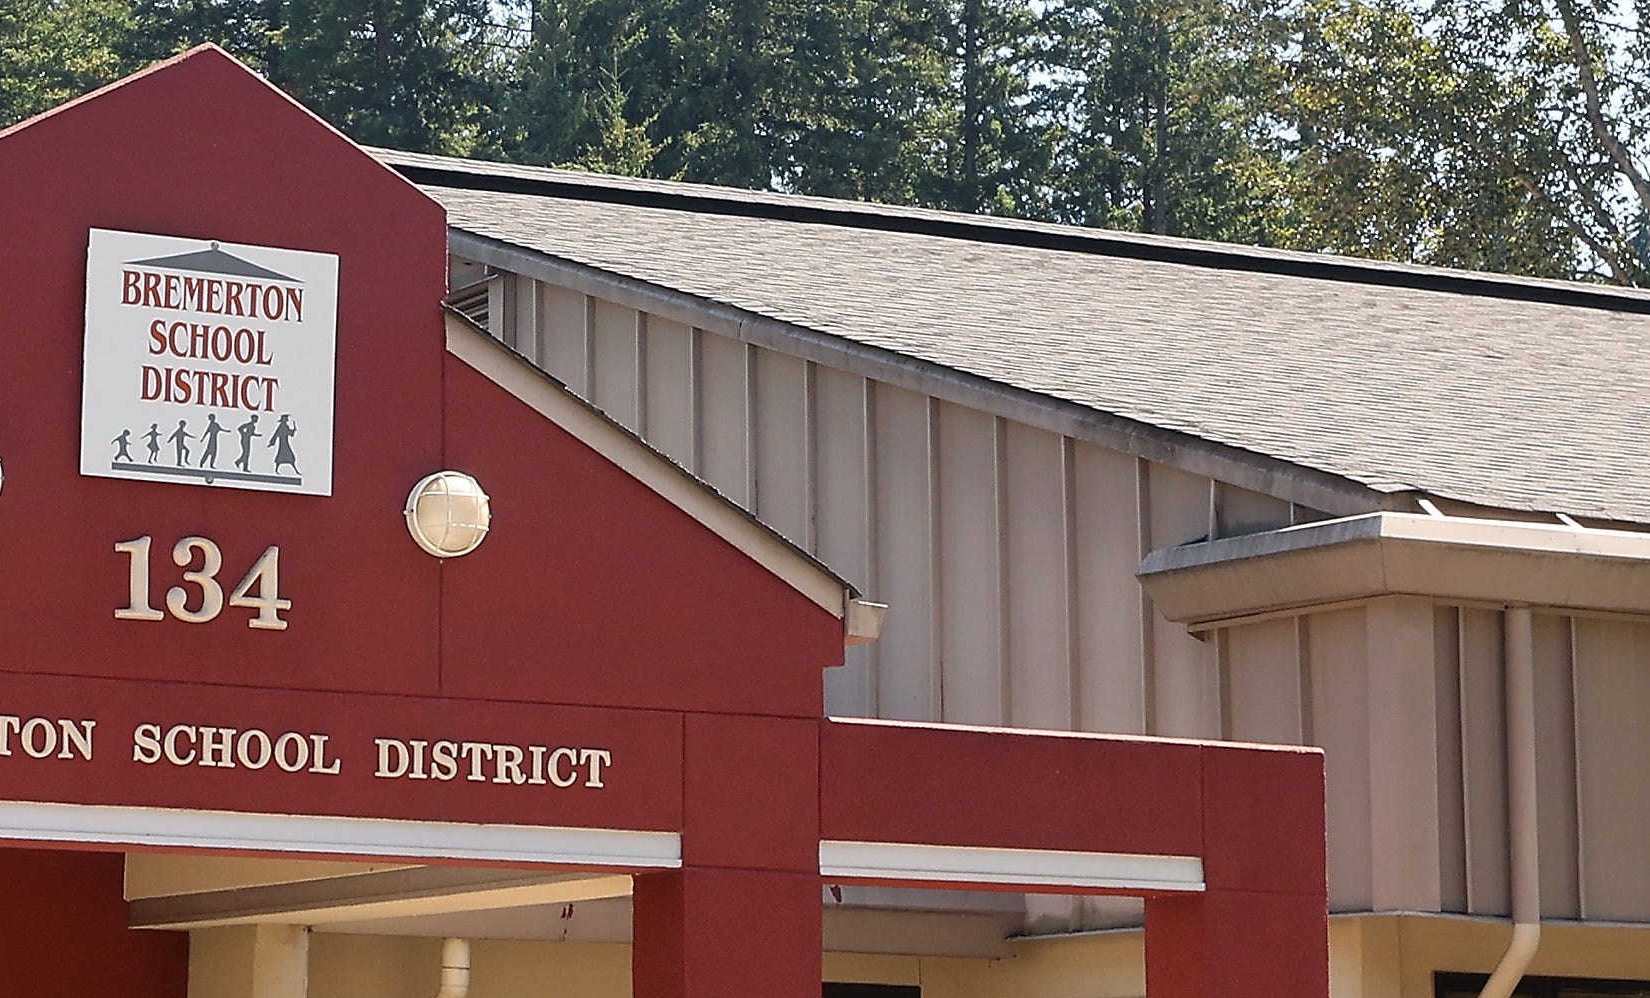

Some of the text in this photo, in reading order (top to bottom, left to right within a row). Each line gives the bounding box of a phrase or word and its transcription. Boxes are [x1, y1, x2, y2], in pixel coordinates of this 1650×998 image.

[121, 270, 304, 322] BREMERTON
[149, 319, 273, 366] SCHOOL
[140, 365, 279, 412] DISTRICT
[114, 535, 292, 630] 134
[133, 723, 341, 776] SCHOOL
[374, 738, 612, 789] DISTRICT
